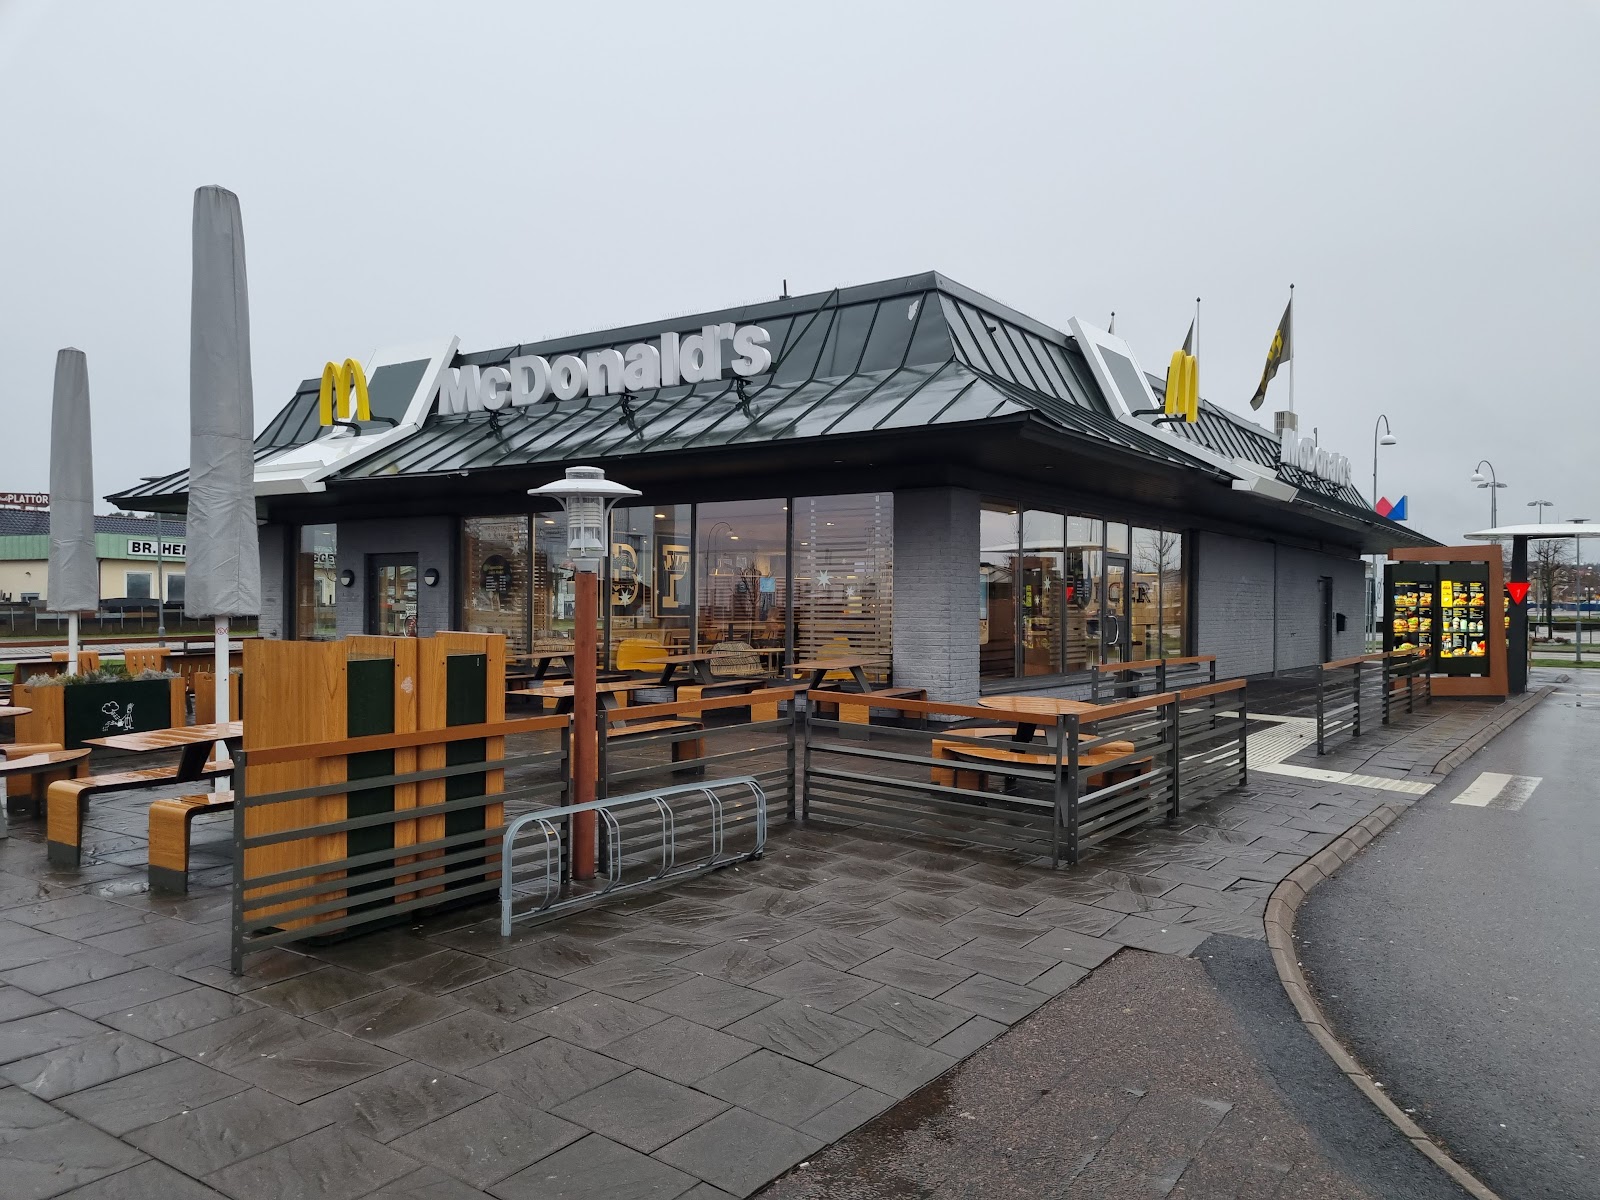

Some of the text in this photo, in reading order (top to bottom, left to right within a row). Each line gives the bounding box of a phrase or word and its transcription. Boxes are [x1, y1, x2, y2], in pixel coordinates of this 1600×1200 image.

[438, 322, 771, 415] McDonald's
[1280, 428, 1351, 488] McDonald's
[132, 542, 156, 553] BR.
